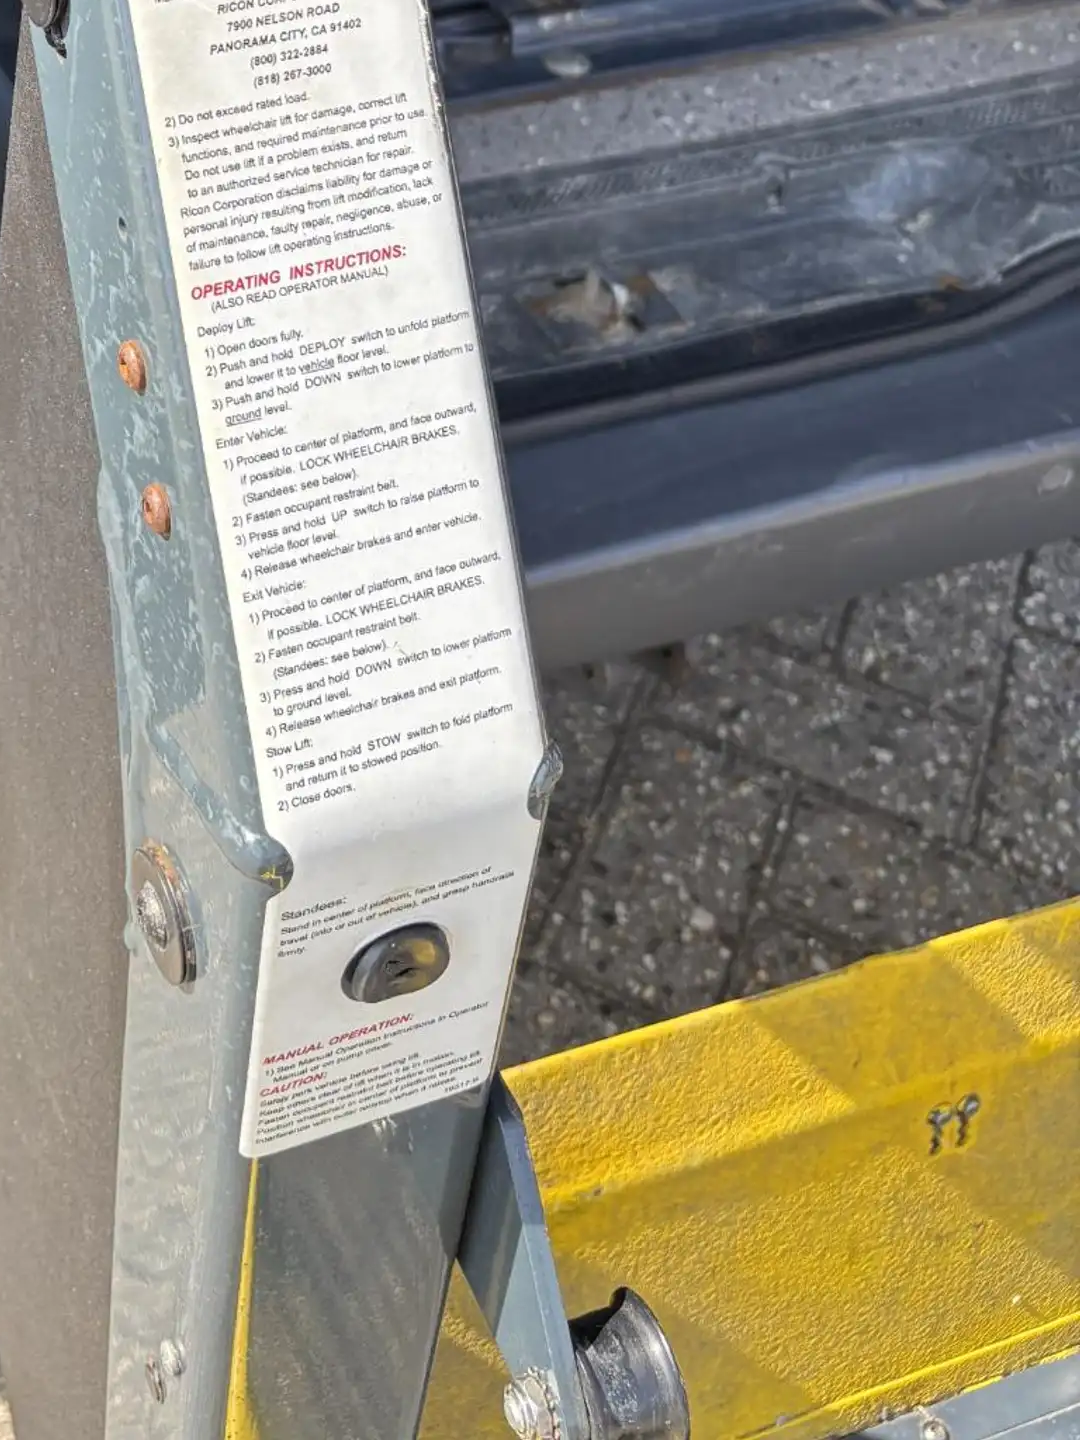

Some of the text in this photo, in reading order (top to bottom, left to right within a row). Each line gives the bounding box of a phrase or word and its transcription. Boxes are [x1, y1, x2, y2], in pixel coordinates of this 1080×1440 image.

[226, 2, 341, 33] 7900 NELSON ROAD
[209, 17, 362, 55] PANORAMA CITY, CA 91402
[250, 43, 329, 71] (800) 322-2884
[253, 62, 332, 90] (818) 267-3000
[164, 115, 177, 129] 2)
[177, 113, 194, 125] Do
[196, 109, 214, 122] not
[215, 101, 254, 118] exceed
[255, 95, 283, 111] rated
[167, 135, 180, 149] 3)
[181, 129, 220, 145] Inspect
[221, 117, 277, 137] wheelchair
[279, 114, 293, 127] lift
[293, 112, 310, 124] for
[357, 95, 394, 111] correct
[394, 92, 408, 104] lift
[191, 244, 406, 300] OPERATING INSTRUCTIONS:
[210, 265, 389, 314] (ALSO READ OPERATOR MANUAL)
[196, 322, 234, 338] Deploy
[204, 346, 216, 360] 1)
[216, 342, 247, 356] Open
[248, 335, 279, 349] doors
[205, 364, 218, 378] 2)
[219, 359, 247, 374] Push
[248, 353, 269, 368] and
[271, 348, 294, 363] hold
[299, 336, 346, 356] DEPLOY
[351, 329, 384, 345] switch
[384, 327, 397, 337] to
[397, 319, 429, 335] unfold
[211, 343, 474, 411] 3) Push and hold DOWN switch to lower platform to
[224, 376, 245, 390] and
[246, 371, 275, 385] lower
[276, 367, 284, 379] it
[285, 366, 297, 377] to
[298, 357, 335, 375] vehicle
[336, 351, 360, 364] floor
[224, 407, 262, 428] ground
[215, 435, 245, 450] Enter
[222, 458, 235, 471] 1)
[236, 448, 280, 467] Proceed
[281, 446, 293, 457] to
[294, 438, 327, 453] center
[329, 432, 340, 446] of
[389, 417, 409, 432] and
[410, 414, 433, 426] face
[240, 473, 247, 486] if
[299, 454, 332, 472] LOCK
[333, 435, 409, 463] WHEELCHAIR
[300, 478, 320, 491] see
[242, 589, 264, 604] Exit
[265, 745, 293, 759] Stow
[272, 703, 513, 779] 1) Press and hold STOW switch to fold platform
[285, 777, 306, 792] and
[307, 769, 339, 786] return
[339, 765, 348, 777] it
[348, 763, 360, 774] to
[361, 750, 398, 770] stowed
[276, 799, 290, 812] 2)
[290, 792, 321, 808] Close
[262, 1041, 325, 1066] MANUAL
[328, 1013, 414, 1046] OPERATION:
[259, 1071, 328, 1098] CAUTION:
